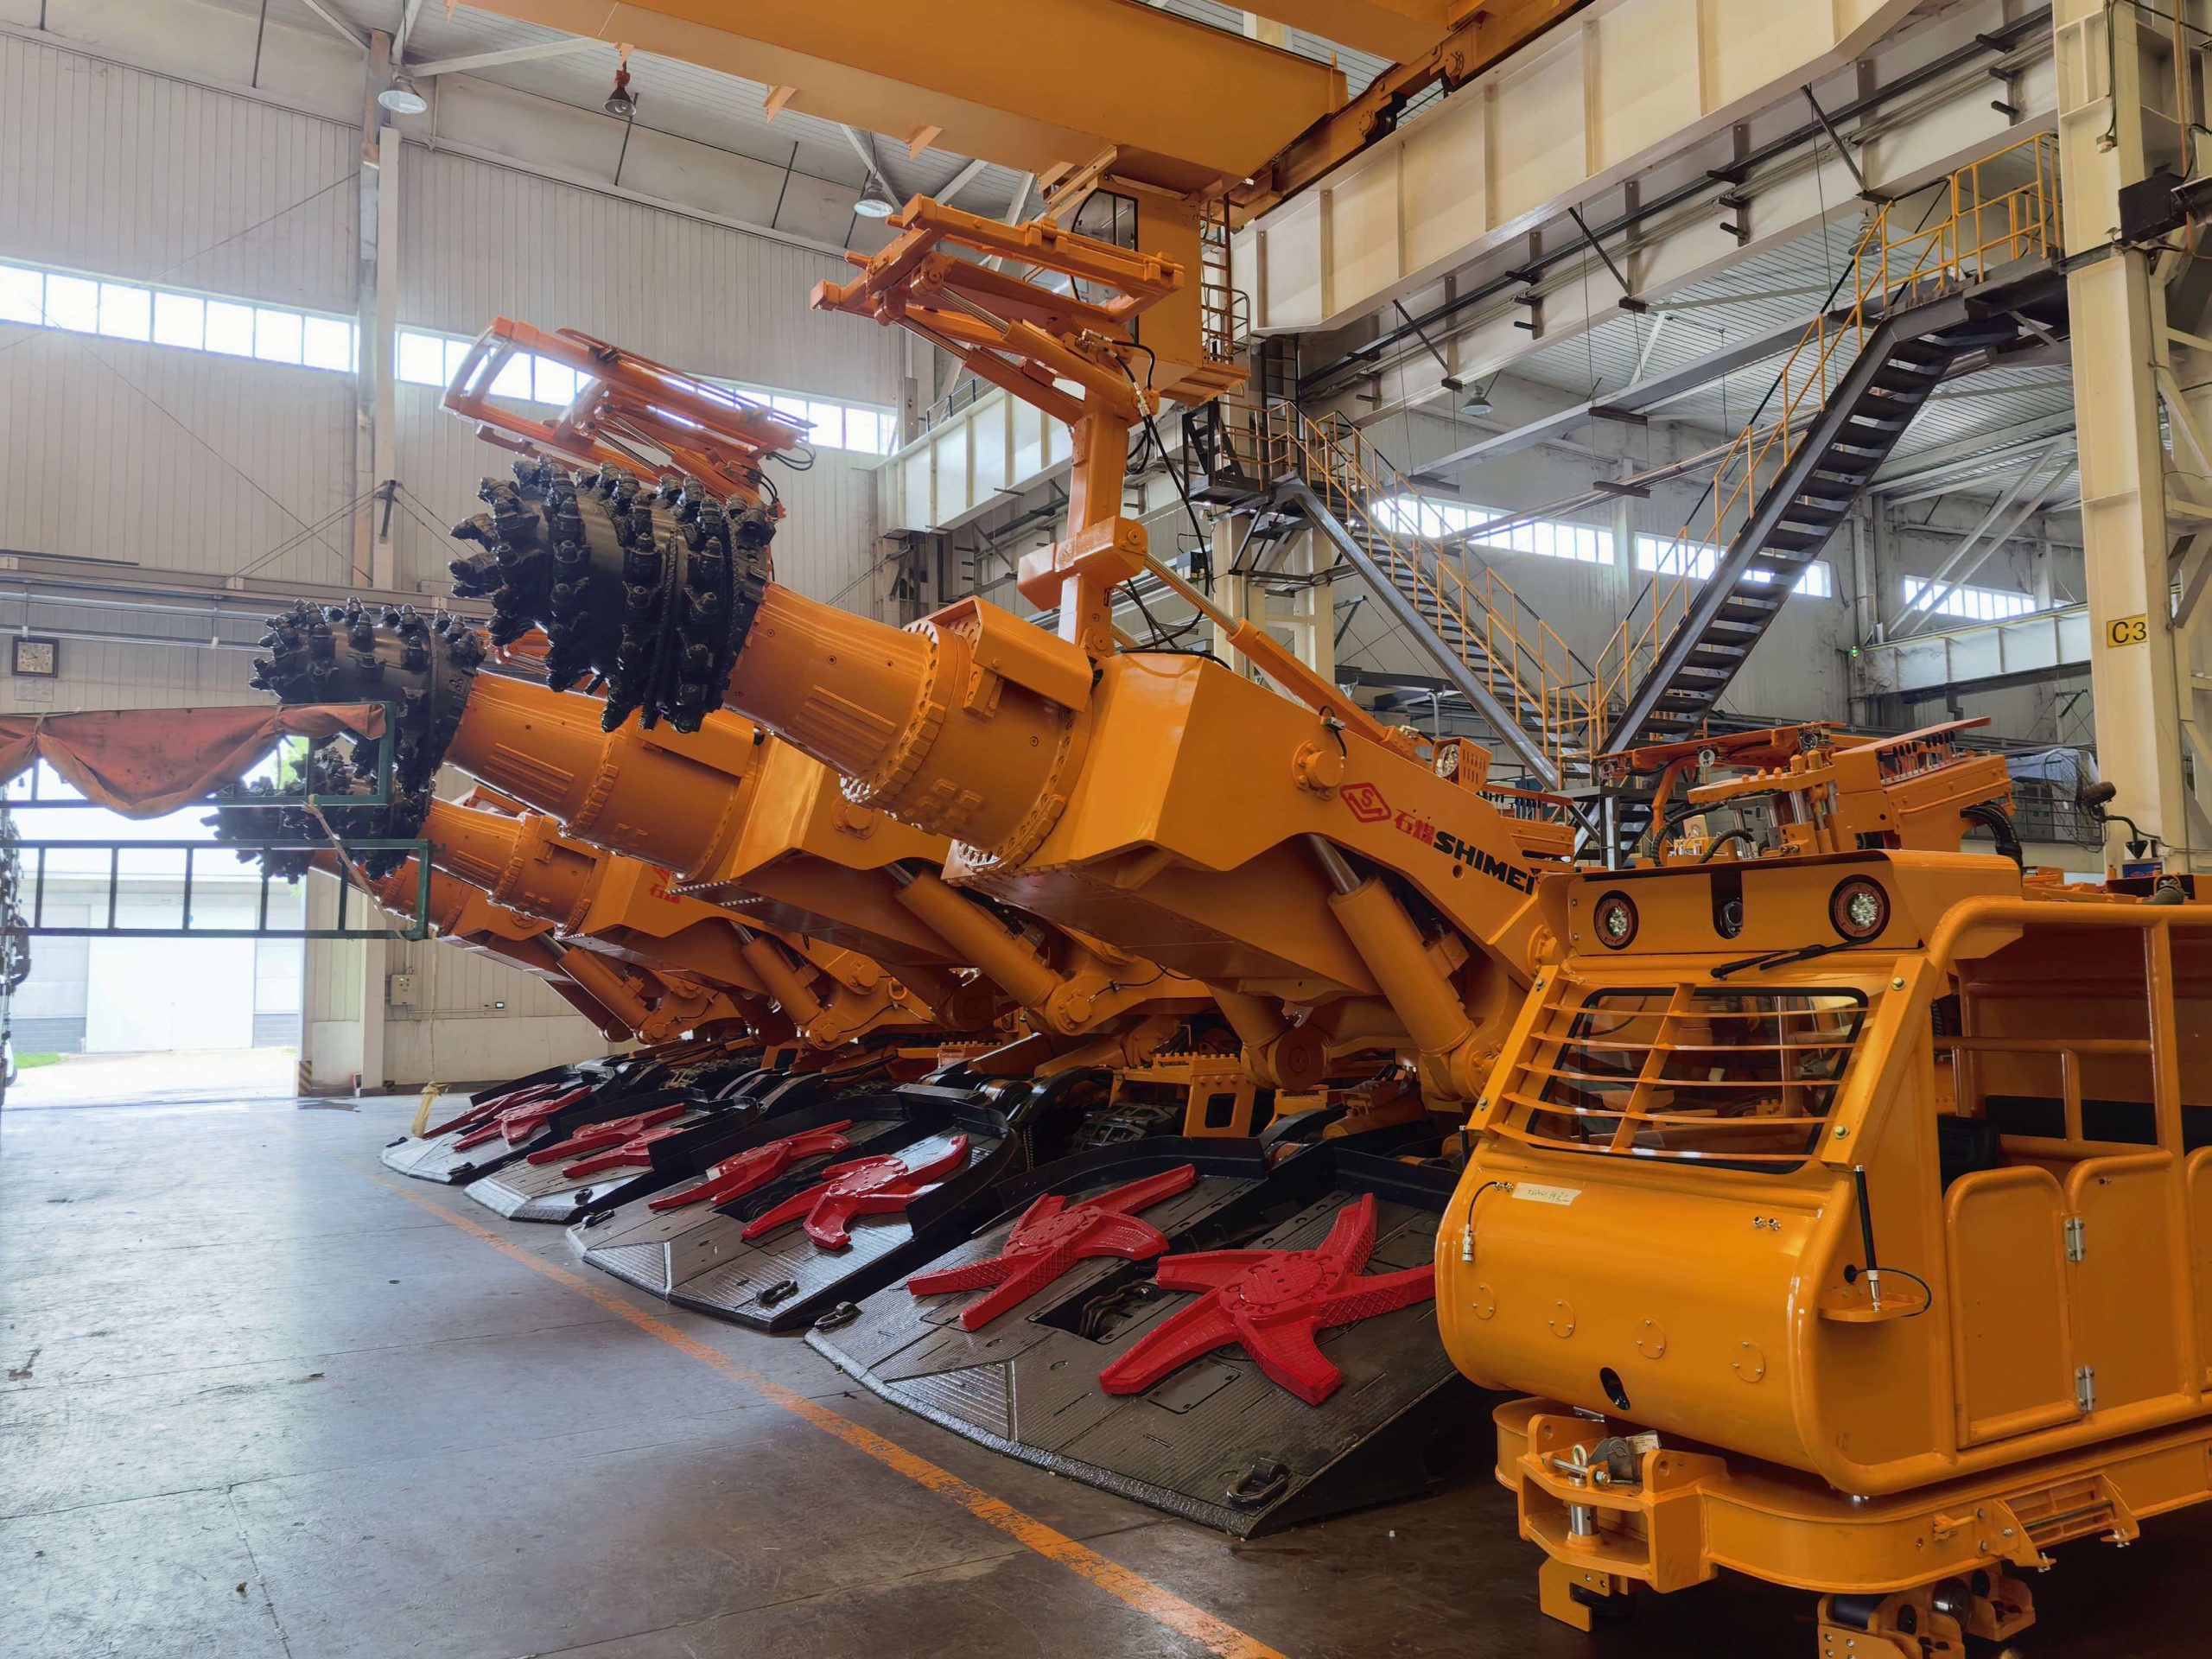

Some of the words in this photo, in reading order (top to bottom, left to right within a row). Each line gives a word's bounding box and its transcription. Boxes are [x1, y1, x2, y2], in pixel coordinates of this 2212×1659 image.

[2112, 621, 2146, 644] C3
[1394, 809, 1435, 846] 石煤
[1433, 831, 1535, 895] SHIMEI
